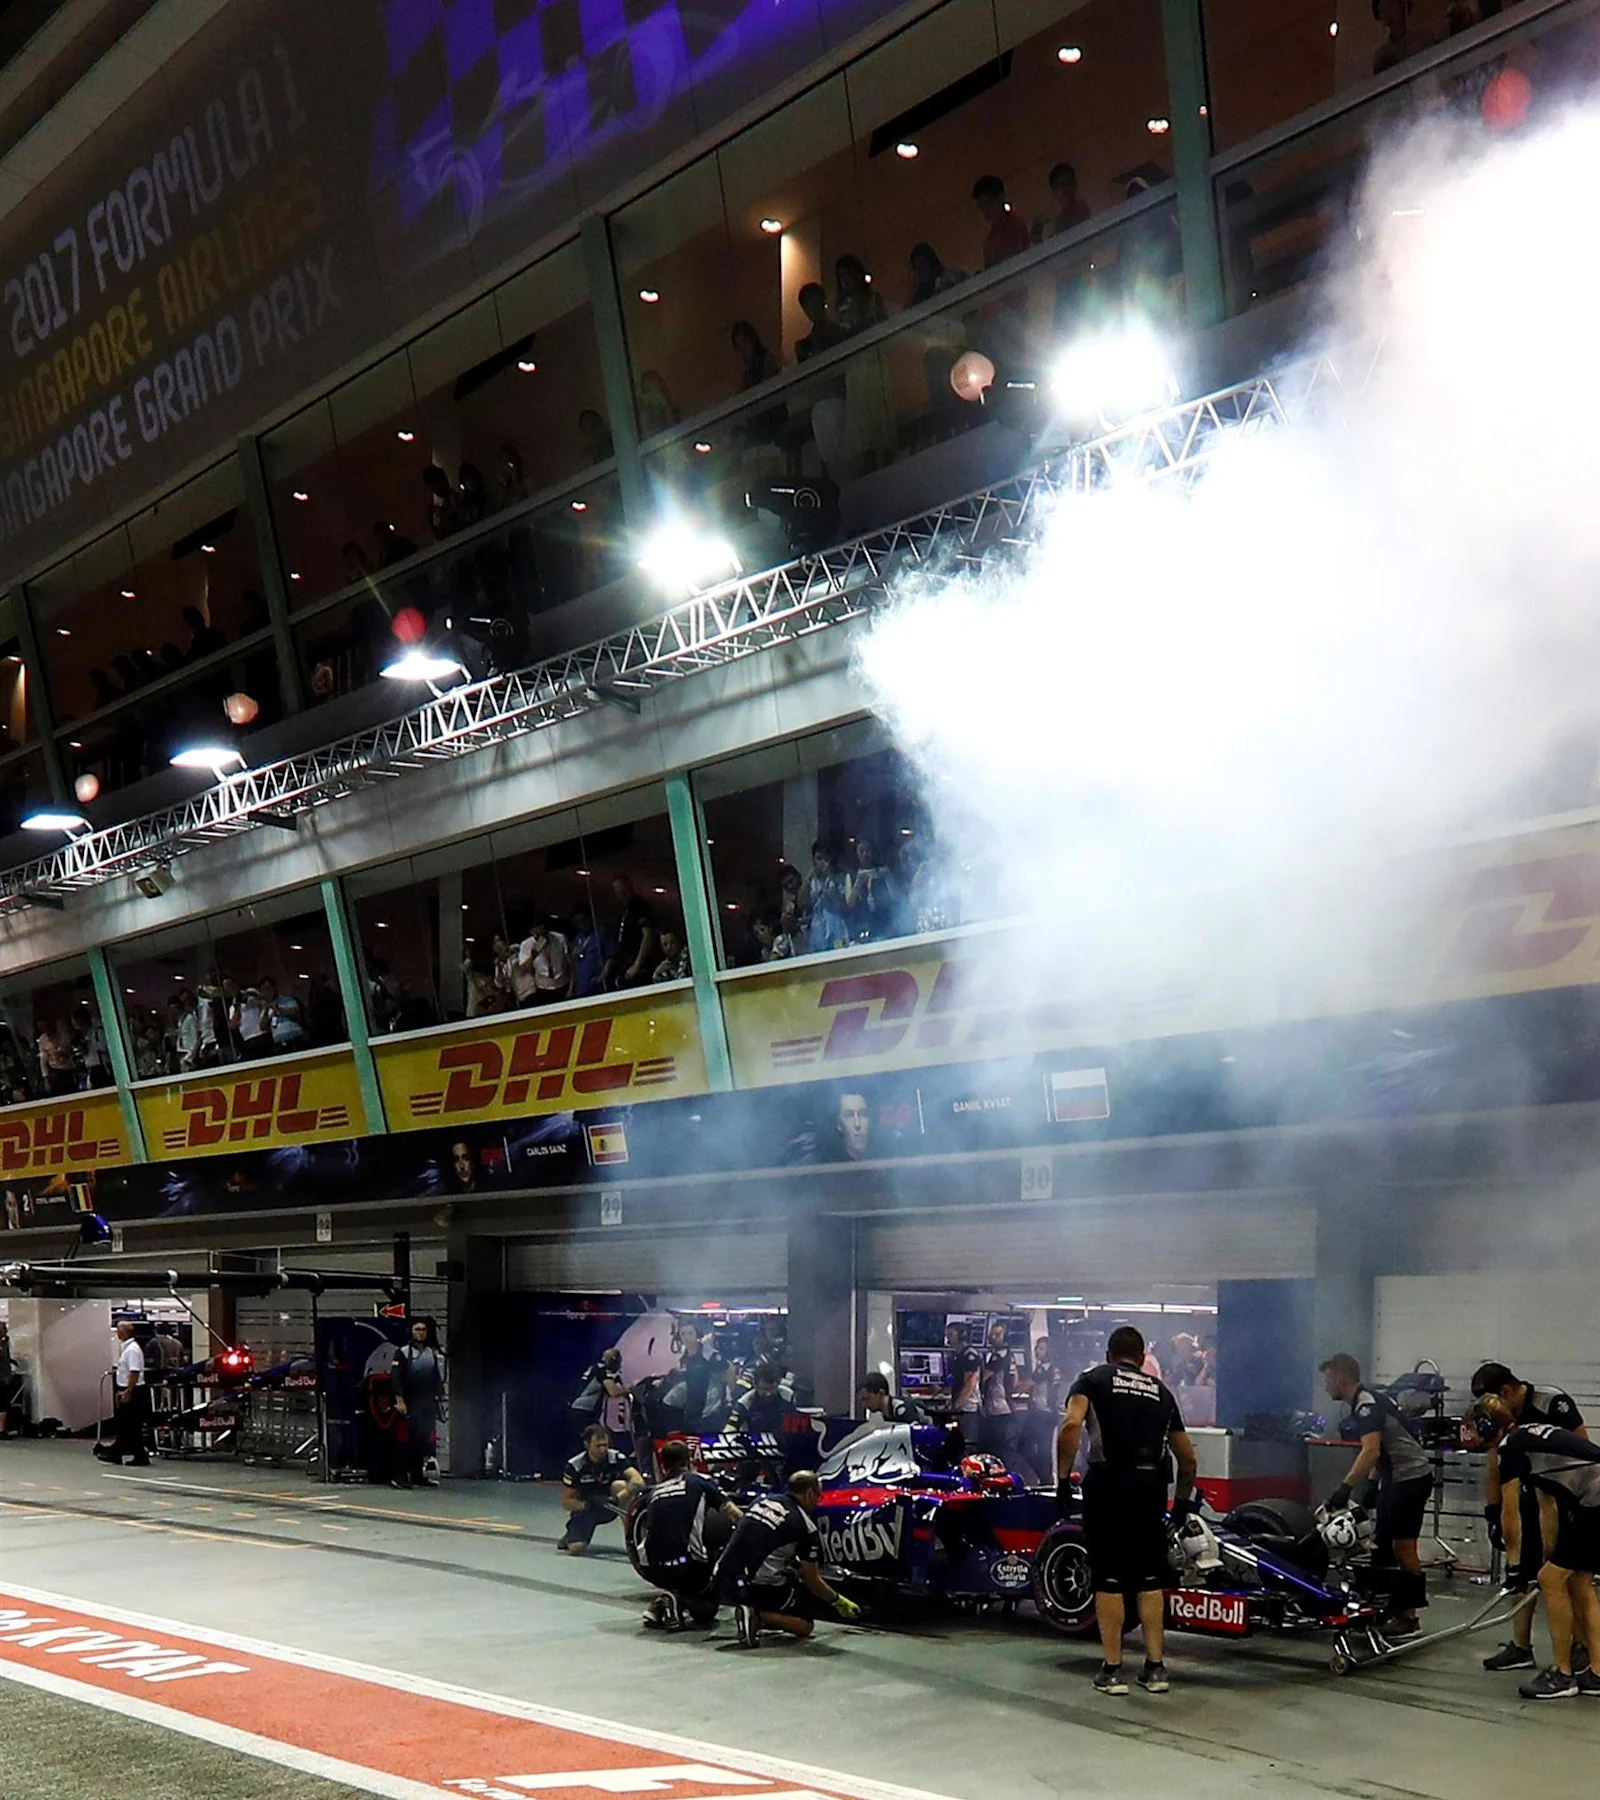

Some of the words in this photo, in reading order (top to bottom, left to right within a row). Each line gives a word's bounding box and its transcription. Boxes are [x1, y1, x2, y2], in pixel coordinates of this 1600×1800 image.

[4, 228, 81, 357] 2017
[86, 65, 273, 293] FORMULA
[0, 393, 132, 540] INGAPORE
[132, 315, 242, 444] GRAND
[249, 244, 342, 367] PRIX
[440, 1019, 633, 1113] DHL
[0, 1110, 98, 1170] DHL
[181, 1073, 319, 1147] DHL
[1024, 1165, 1050, 1190] 30
[0, 1626, 251, 1682] KVYAT
